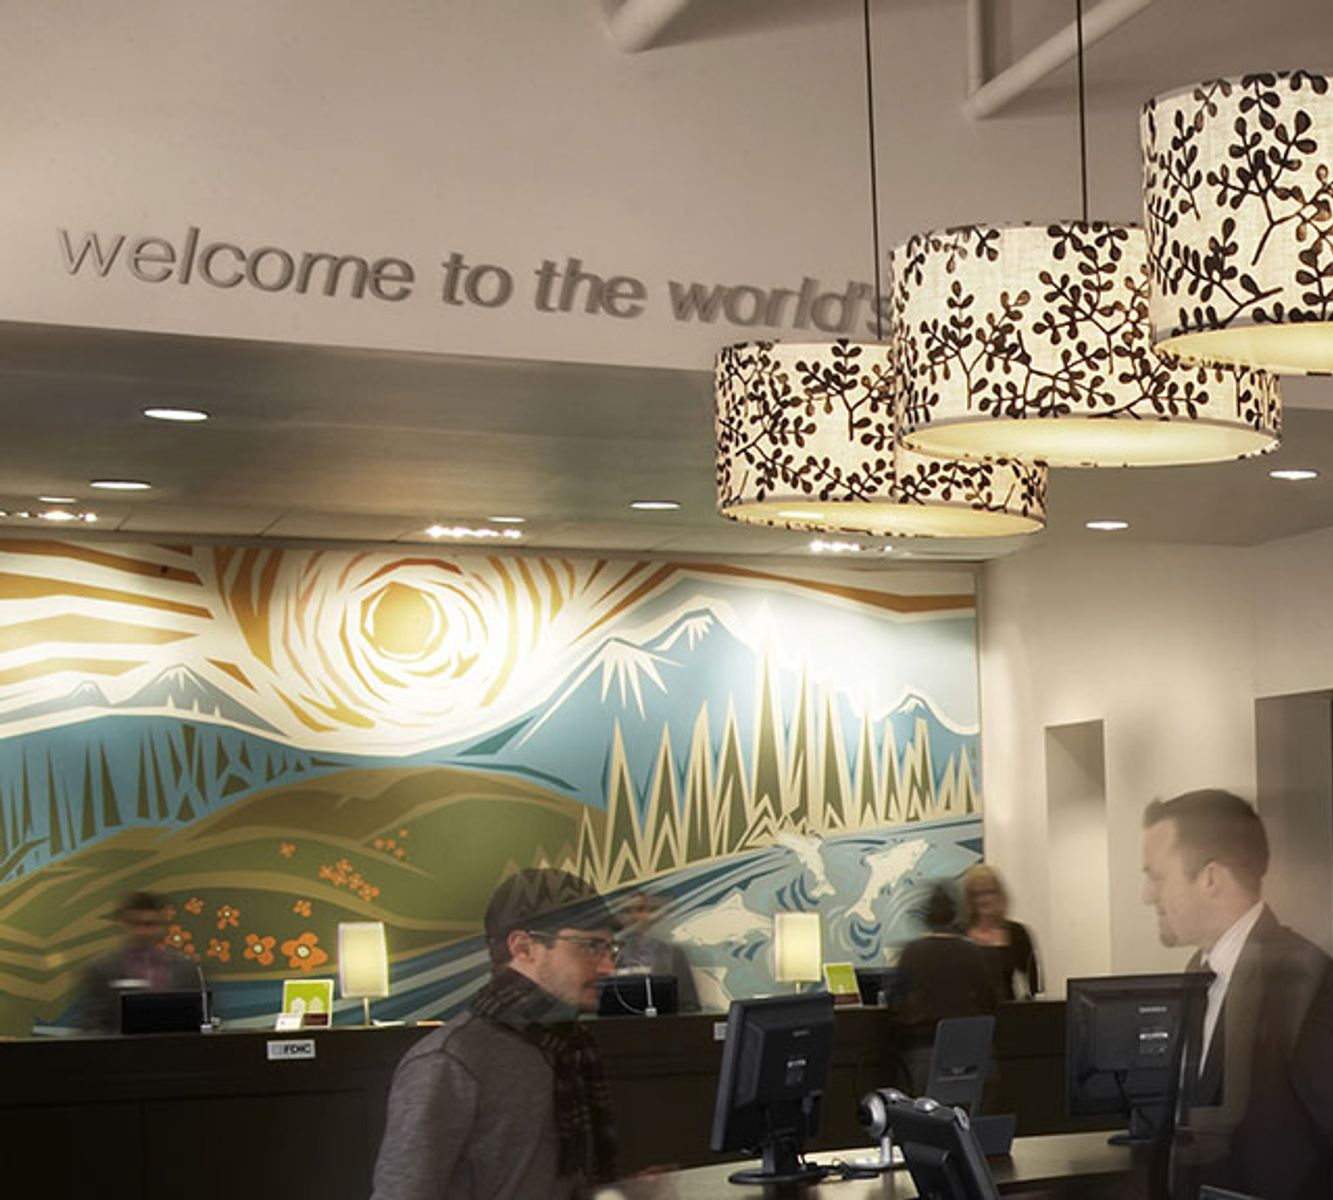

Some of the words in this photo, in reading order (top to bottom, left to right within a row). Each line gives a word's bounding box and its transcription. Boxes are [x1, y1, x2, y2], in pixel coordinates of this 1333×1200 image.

[57, 226, 415, 301] welcome
[441, 251, 514, 309] to
[534, 257, 648, 319] the
